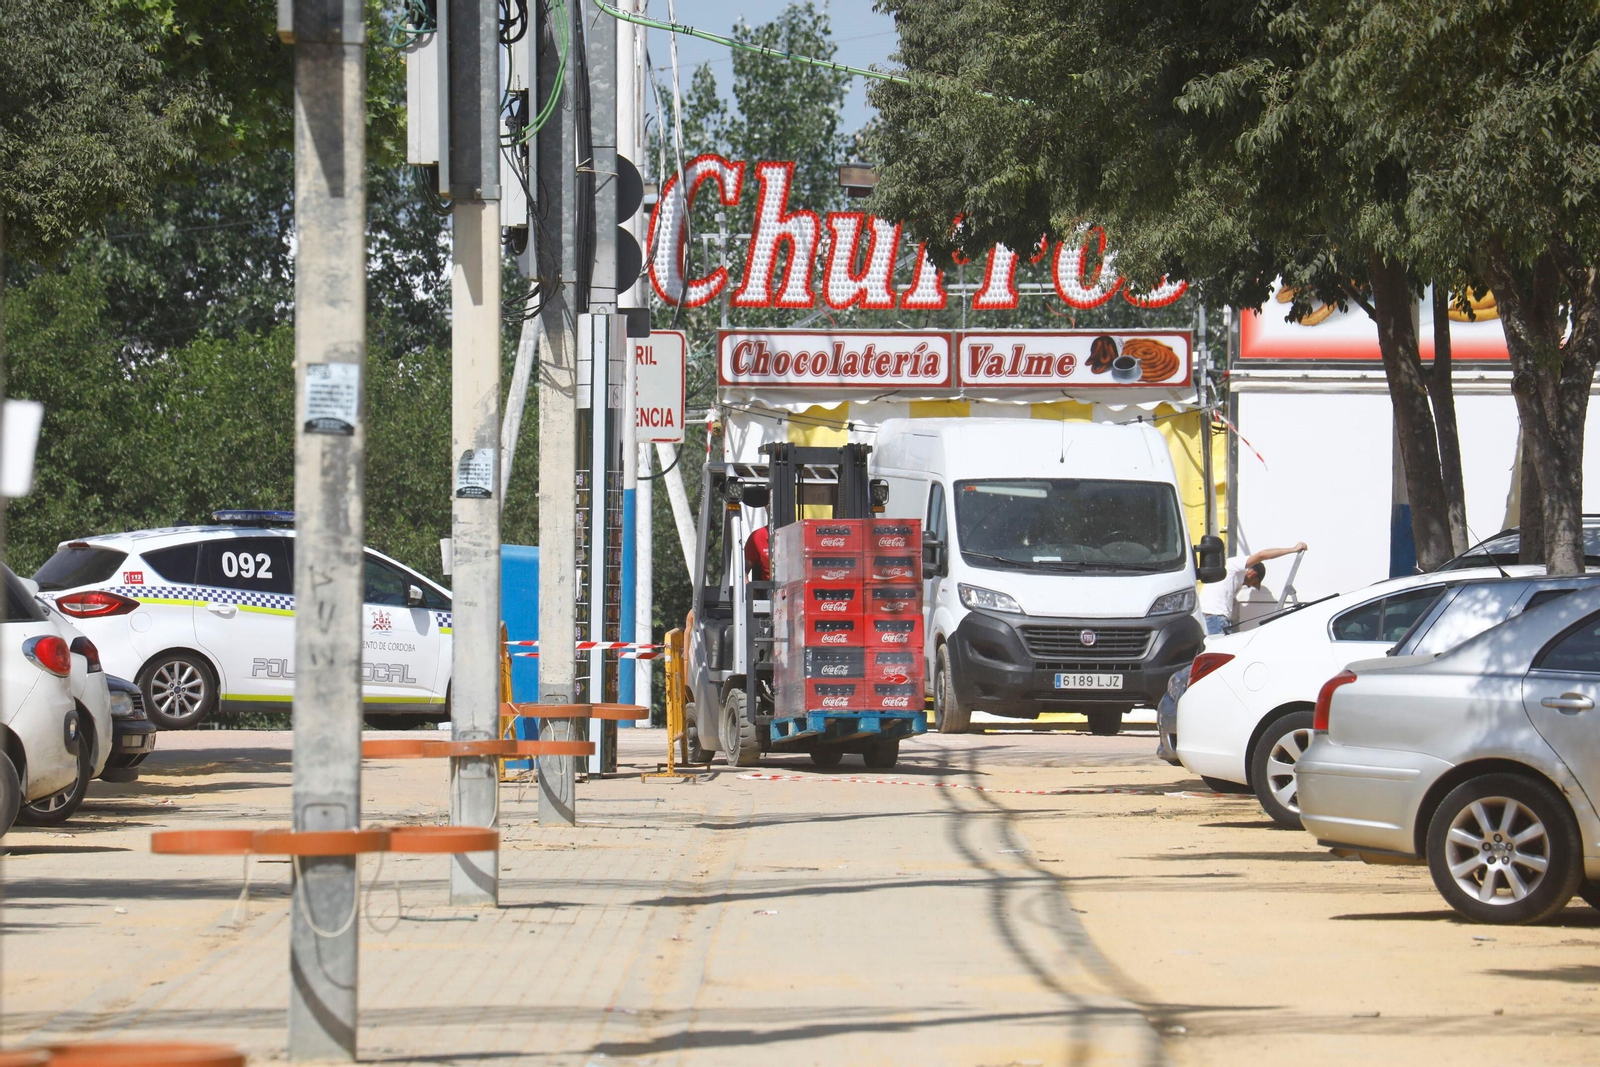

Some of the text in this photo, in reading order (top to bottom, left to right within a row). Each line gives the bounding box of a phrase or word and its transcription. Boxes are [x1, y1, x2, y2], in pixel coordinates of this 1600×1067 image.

[647, 154, 1188, 309] Churro
[635, 345, 657, 365] RIL
[731, 339, 1077, 378] Chocolatería Valme
[221, 551, 273, 579] 092
[379, 641, 386, 650] DE
[387, 642, 416, 652] CORDOBA
[251, 657, 417, 684] POL OCAL
[1063, 675, 1120, 688] 6189 LJZ
